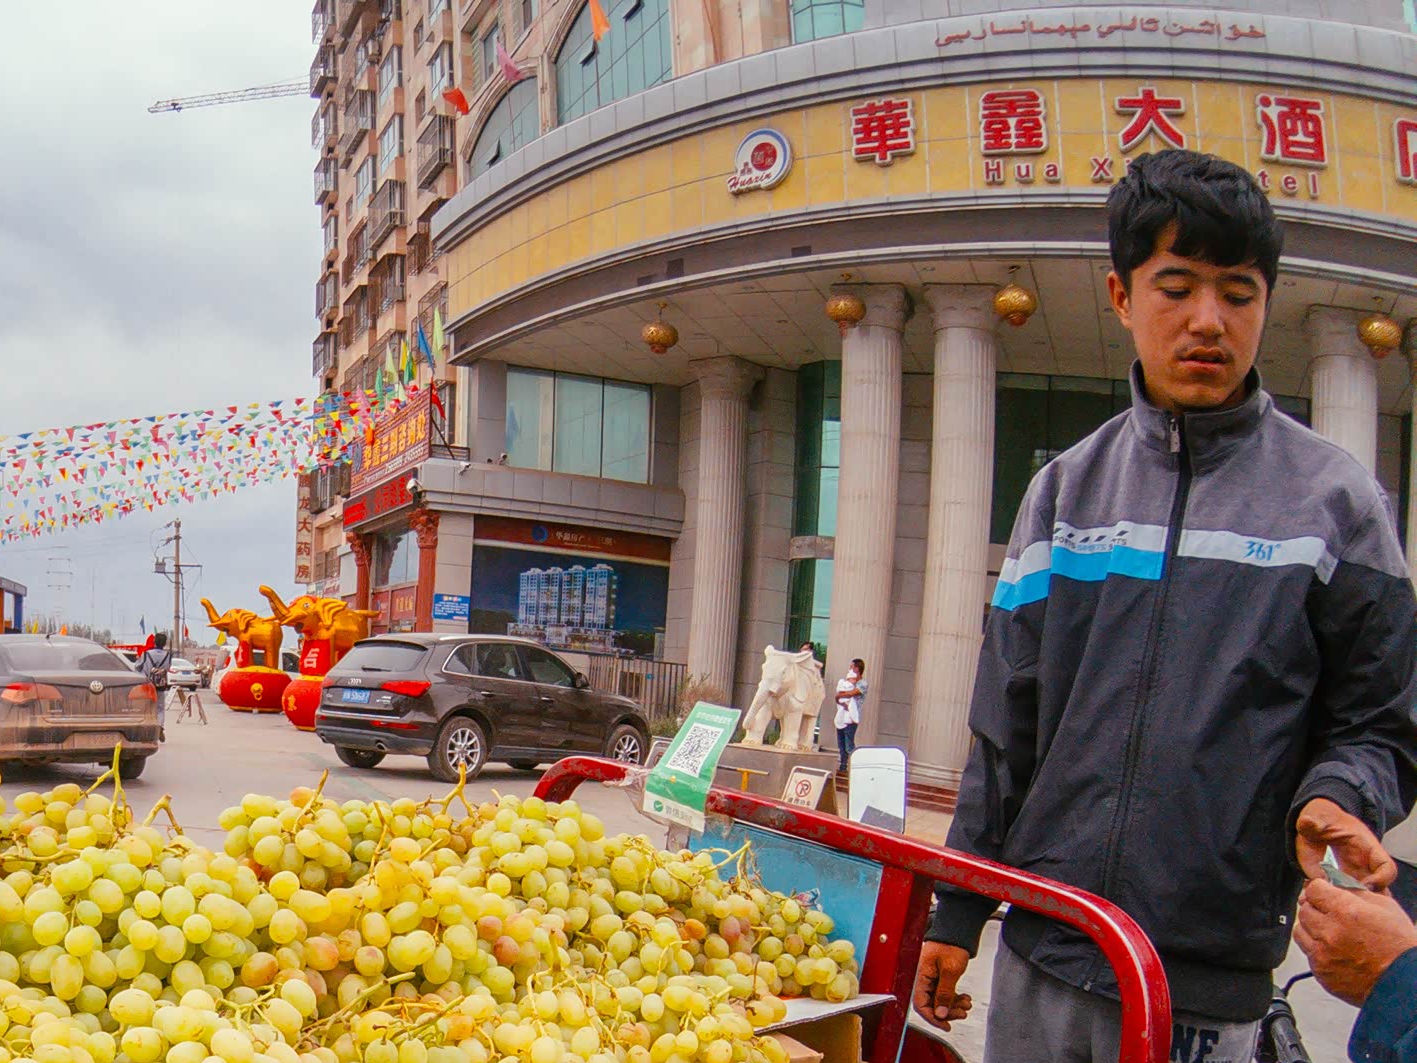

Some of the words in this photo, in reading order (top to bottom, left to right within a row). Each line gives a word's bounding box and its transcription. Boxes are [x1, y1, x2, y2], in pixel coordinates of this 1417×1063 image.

[727, 171, 772, 190] Huaxin
[983, 159, 1062, 184] Hua
[1256, 168, 1320, 198] tel
